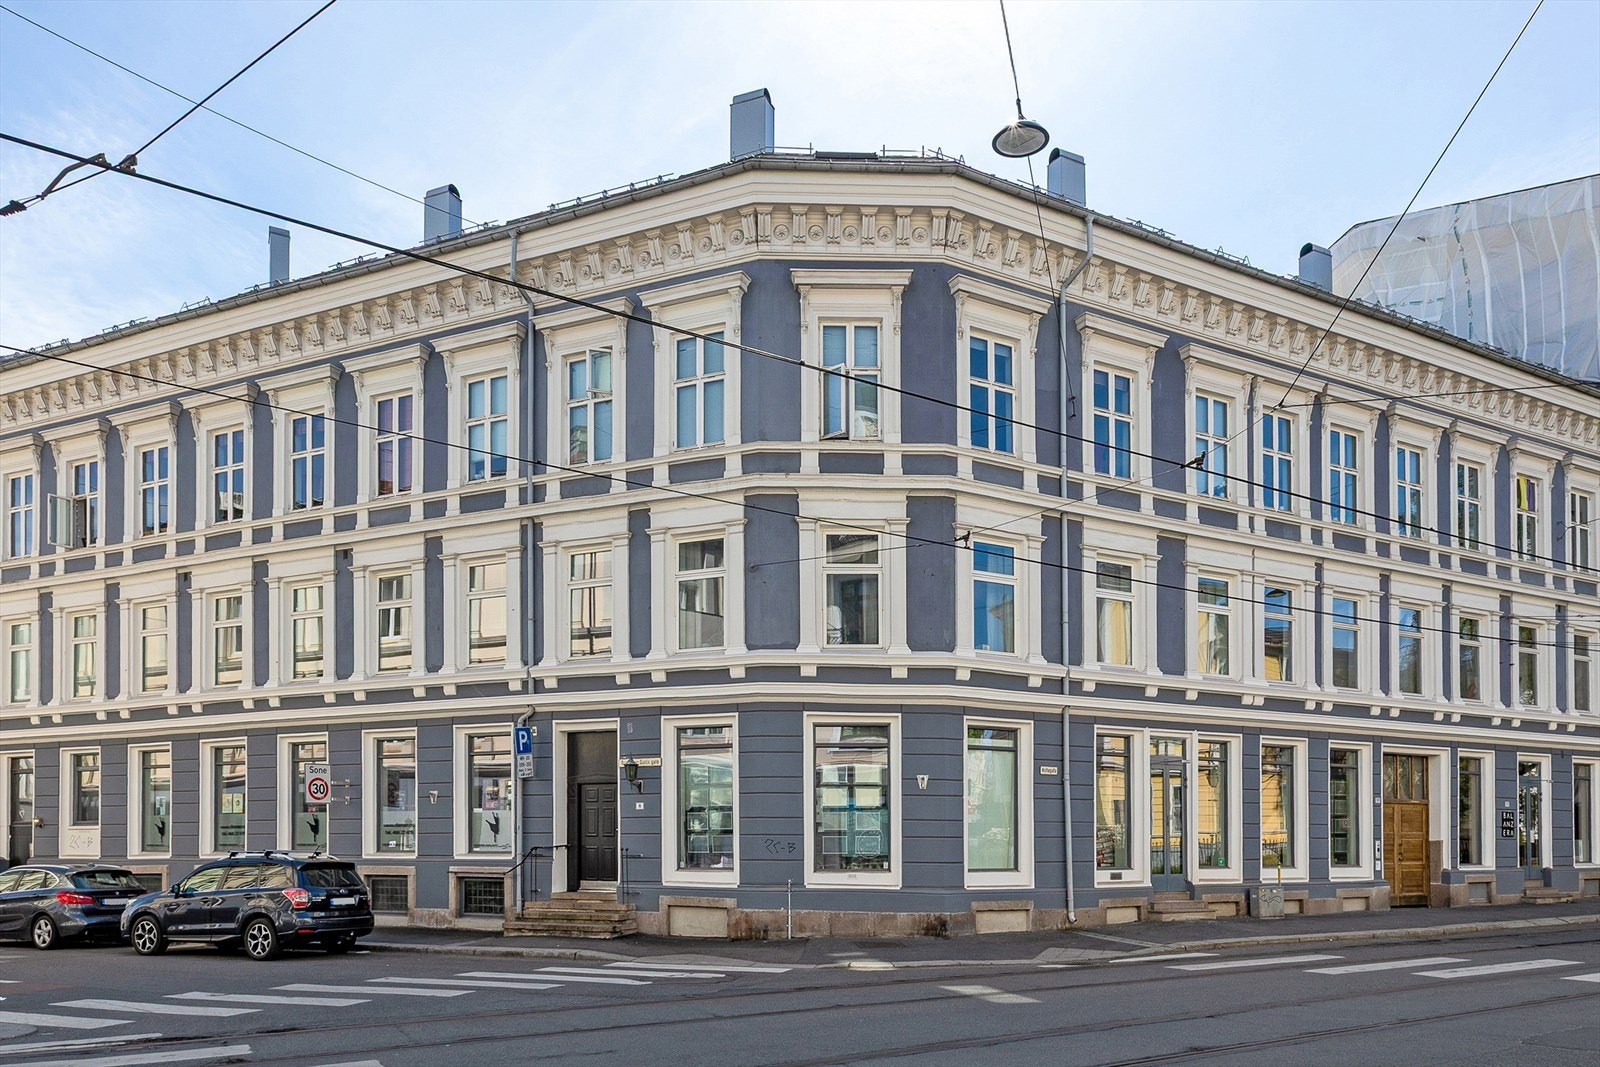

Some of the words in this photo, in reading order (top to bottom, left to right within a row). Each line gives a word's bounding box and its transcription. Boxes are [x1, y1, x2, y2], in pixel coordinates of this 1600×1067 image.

[518, 730, 528, 751] P
[309, 766, 328, 774] Sone
[312, 783, 326, 794] 30
